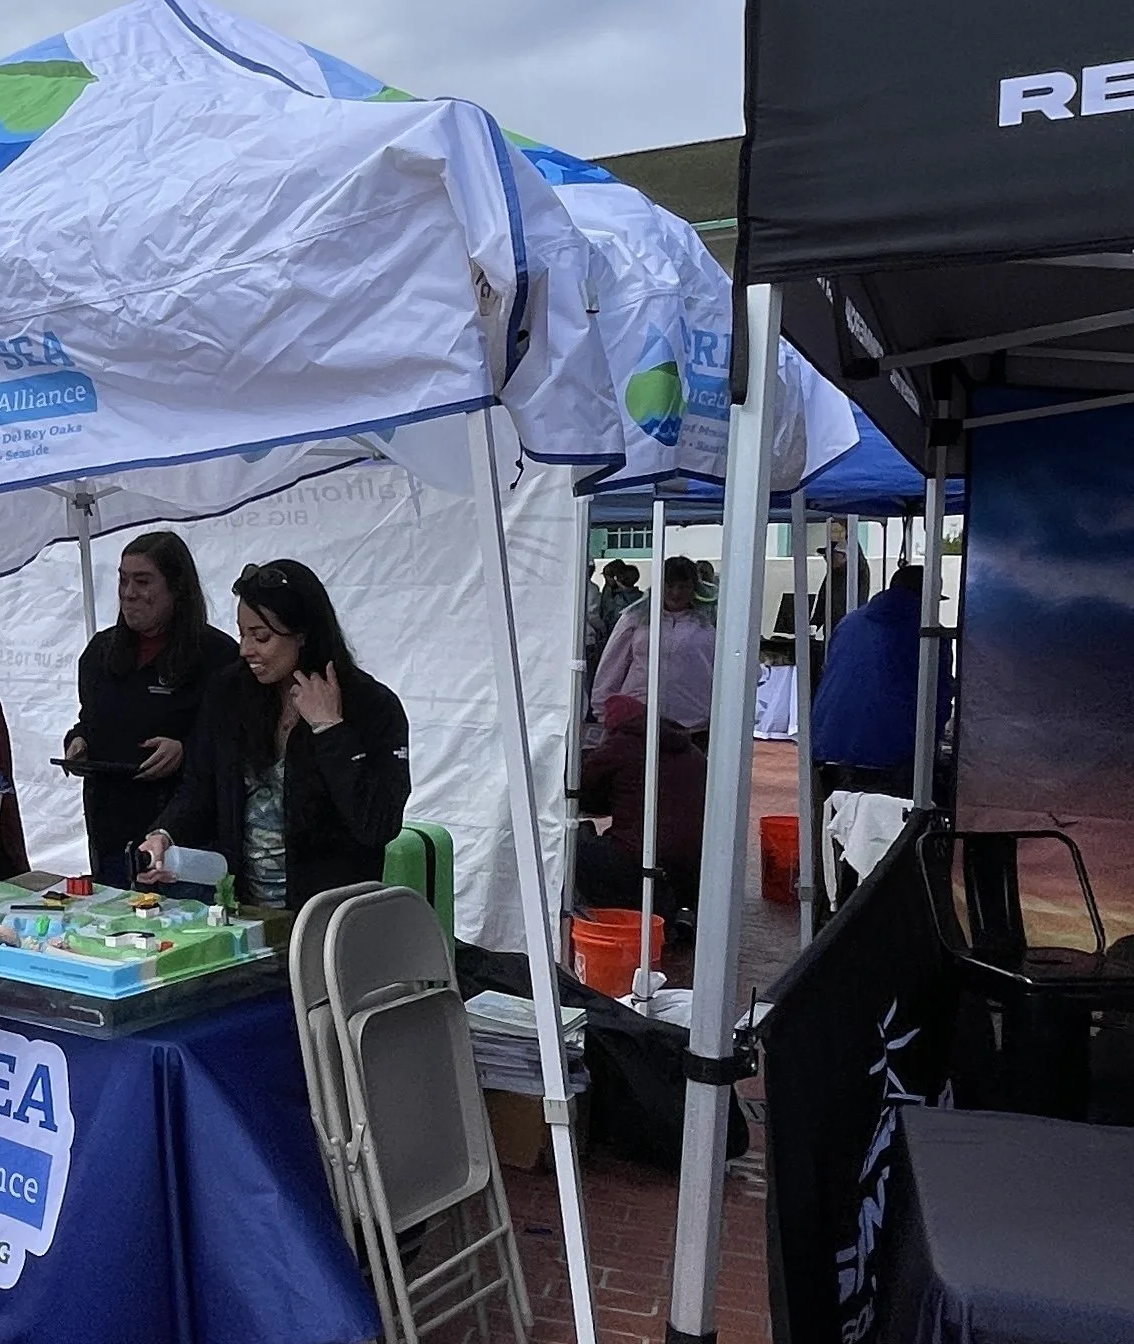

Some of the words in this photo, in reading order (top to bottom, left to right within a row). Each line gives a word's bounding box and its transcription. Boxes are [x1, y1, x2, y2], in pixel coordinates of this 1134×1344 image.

[998, 59, 1134, 127] RE
[2, 430, 22, 444] Del
[24, 428, 46, 441] Rey
[49, 423, 83, 436] Oaks
[5, 445, 50, 461] Seaside
